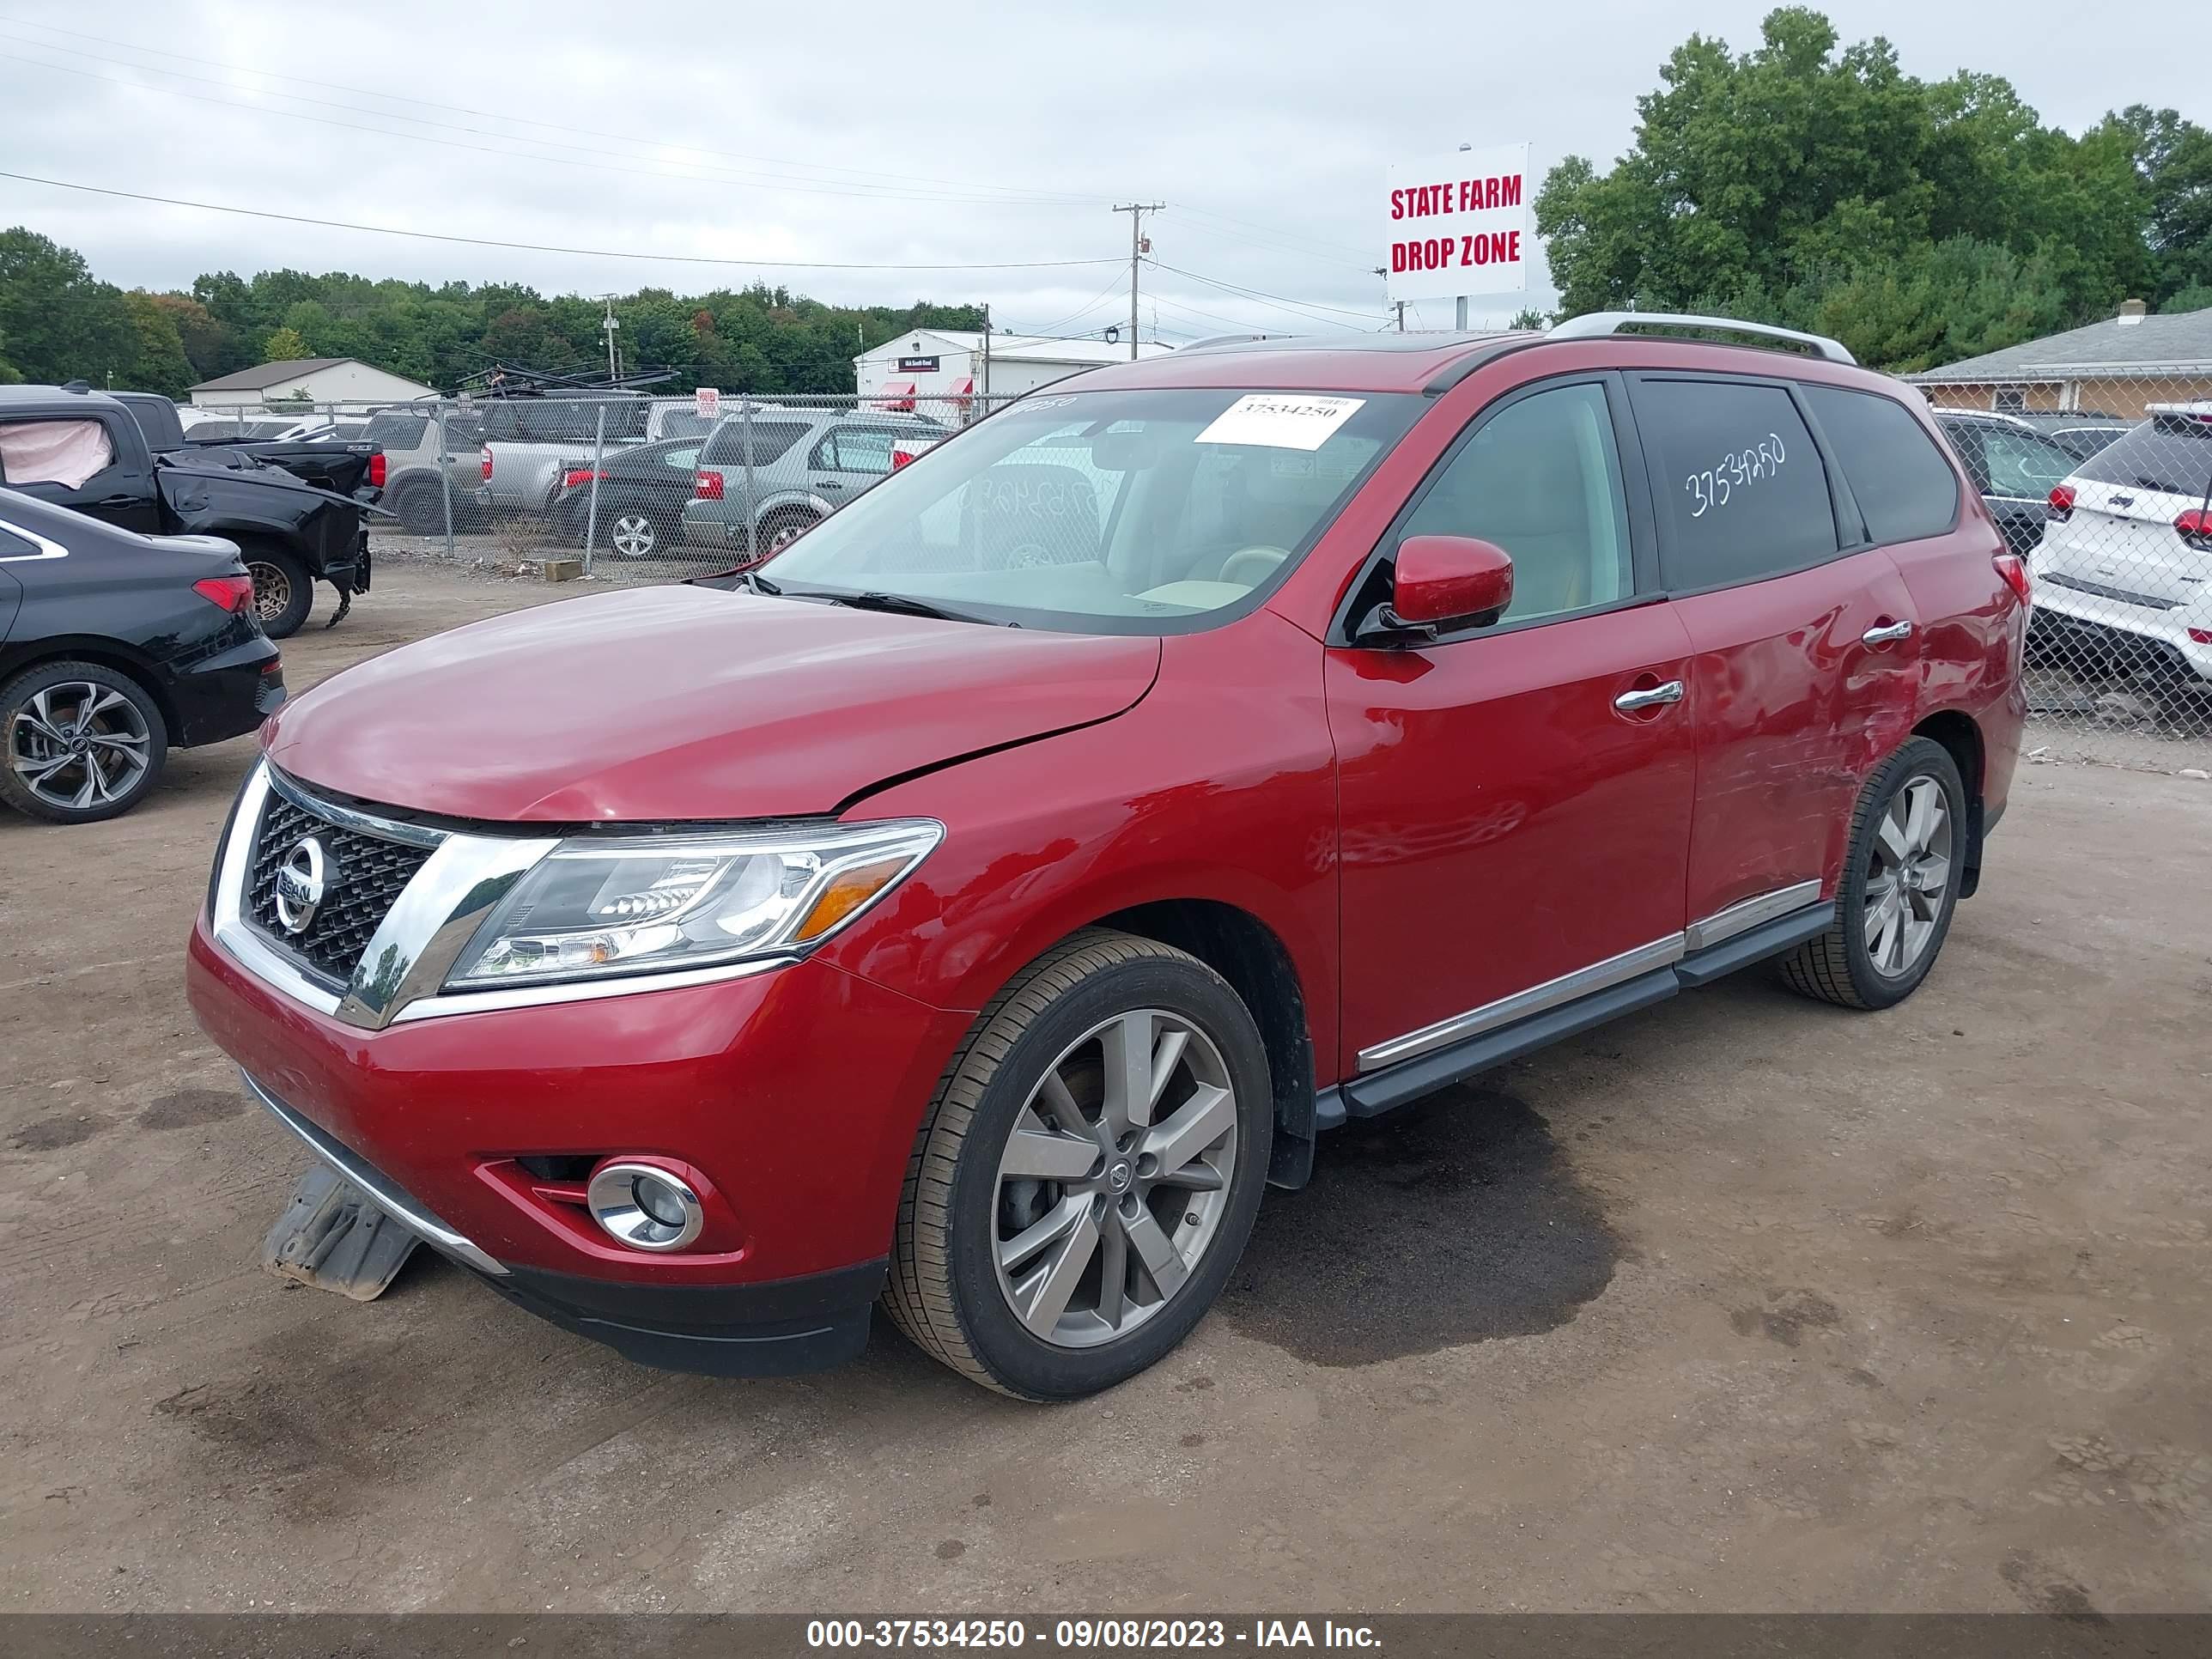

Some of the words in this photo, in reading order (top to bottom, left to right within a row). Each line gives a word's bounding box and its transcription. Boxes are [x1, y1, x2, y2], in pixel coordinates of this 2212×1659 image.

[1391, 183, 1453, 220] STATE
[1460, 174, 1522, 212] FARM
[1392, 238, 1455, 273] DROP
[1461, 230, 1520, 267] ZONE
[1238, 404, 1338, 418] 37534250
[1685, 433, 1785, 517] 37534250
